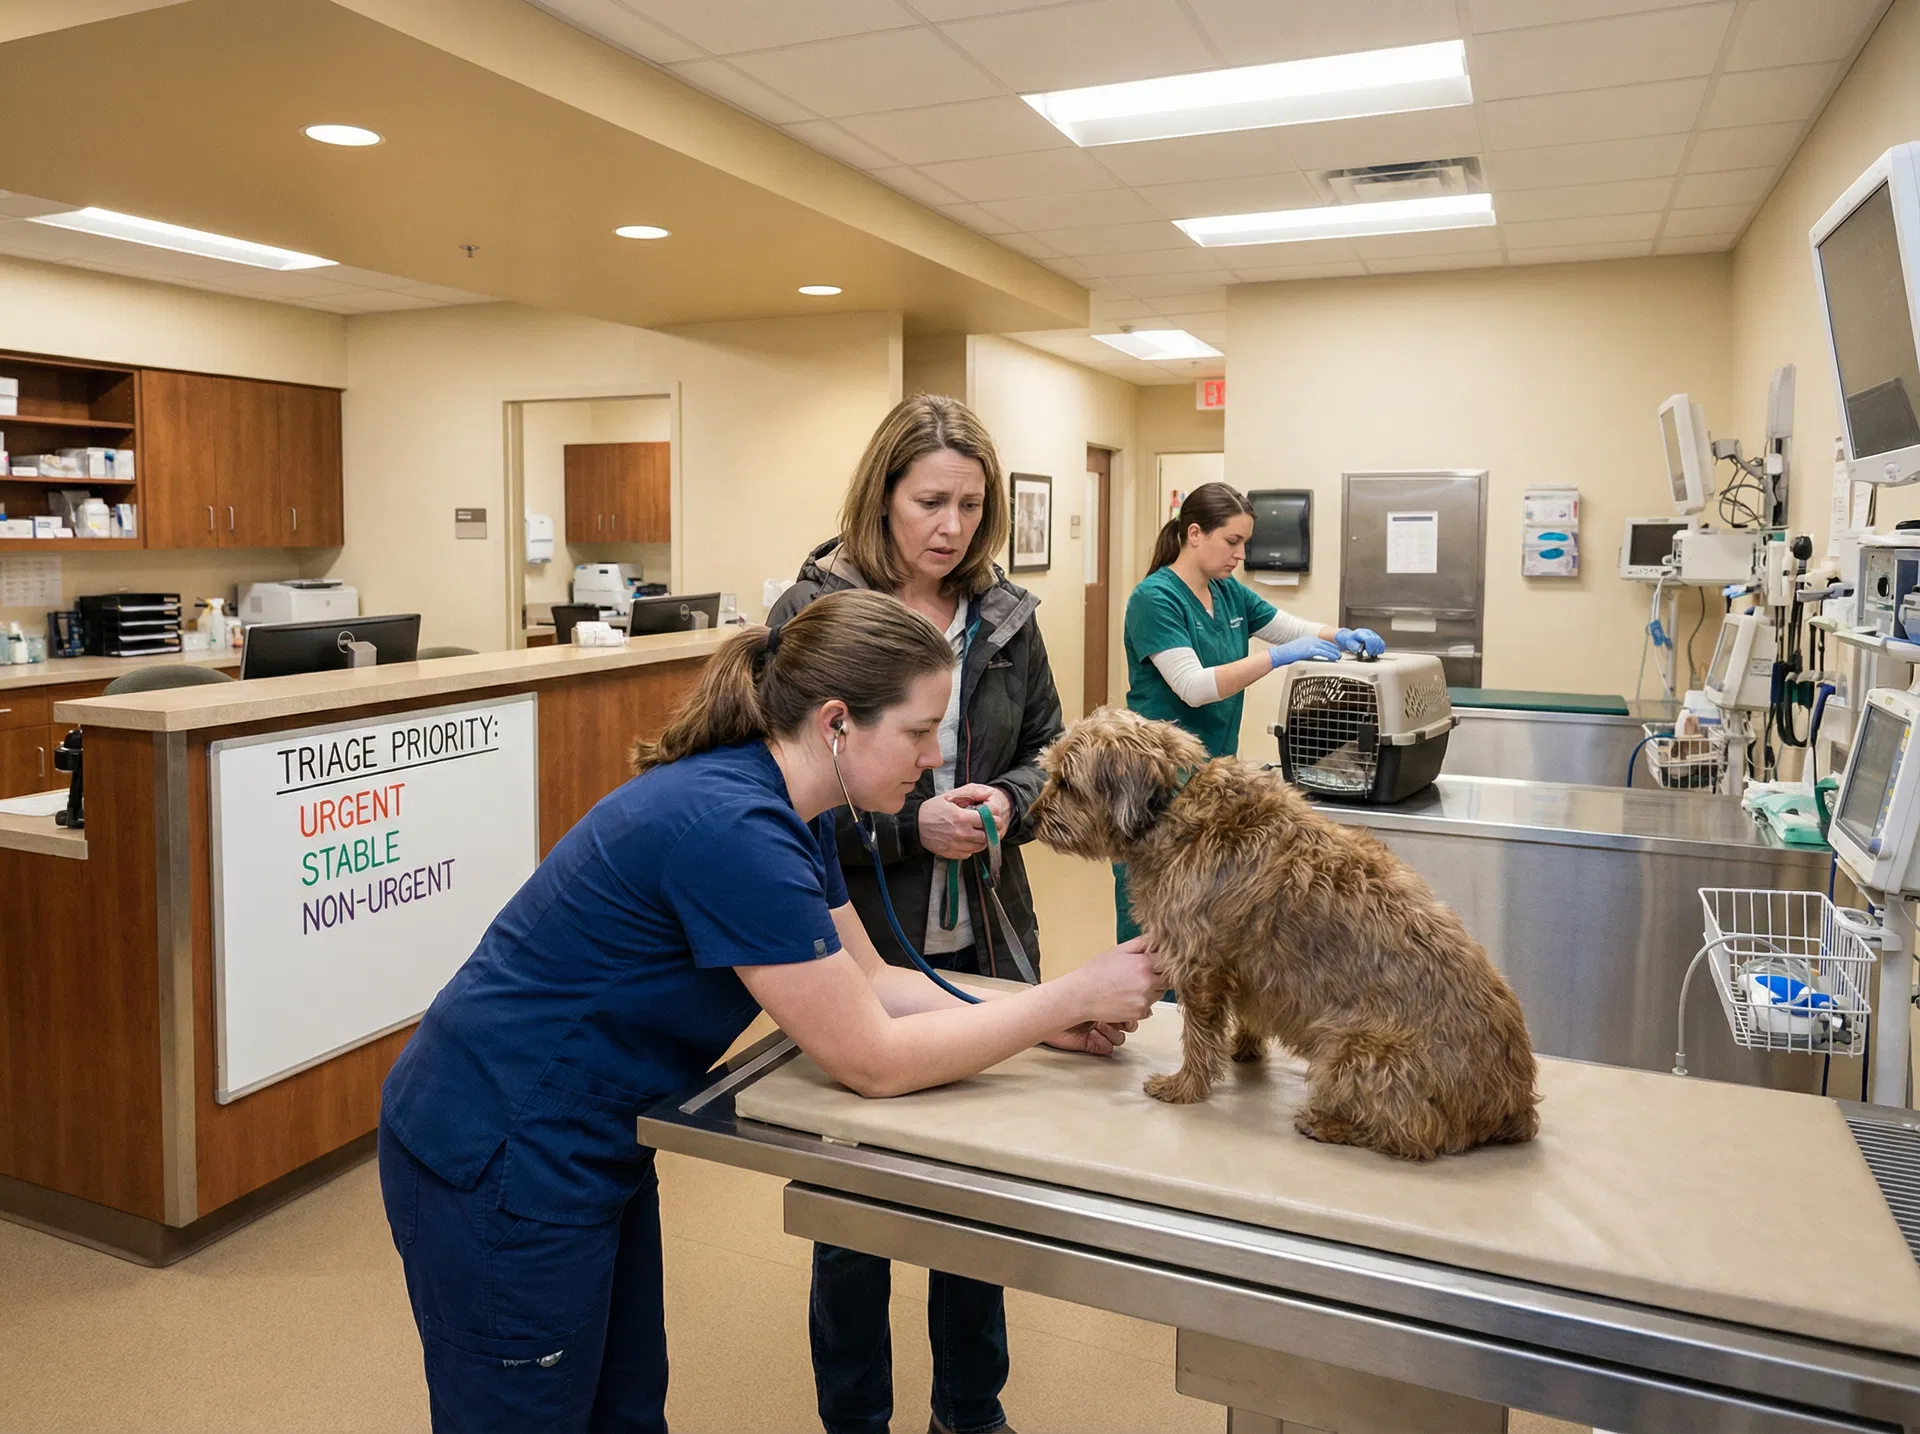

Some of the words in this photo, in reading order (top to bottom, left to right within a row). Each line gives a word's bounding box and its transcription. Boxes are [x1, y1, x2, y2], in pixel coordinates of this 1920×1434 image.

[1203, 380, 1225, 407] EX
[277, 736, 378, 784] TRIAGE
[392, 715, 499, 762] PRIORITY:
[300, 783, 405, 838] URGENT
[302, 830, 400, 886] STABLE
[303, 859, 455, 935] NON-URGENT
